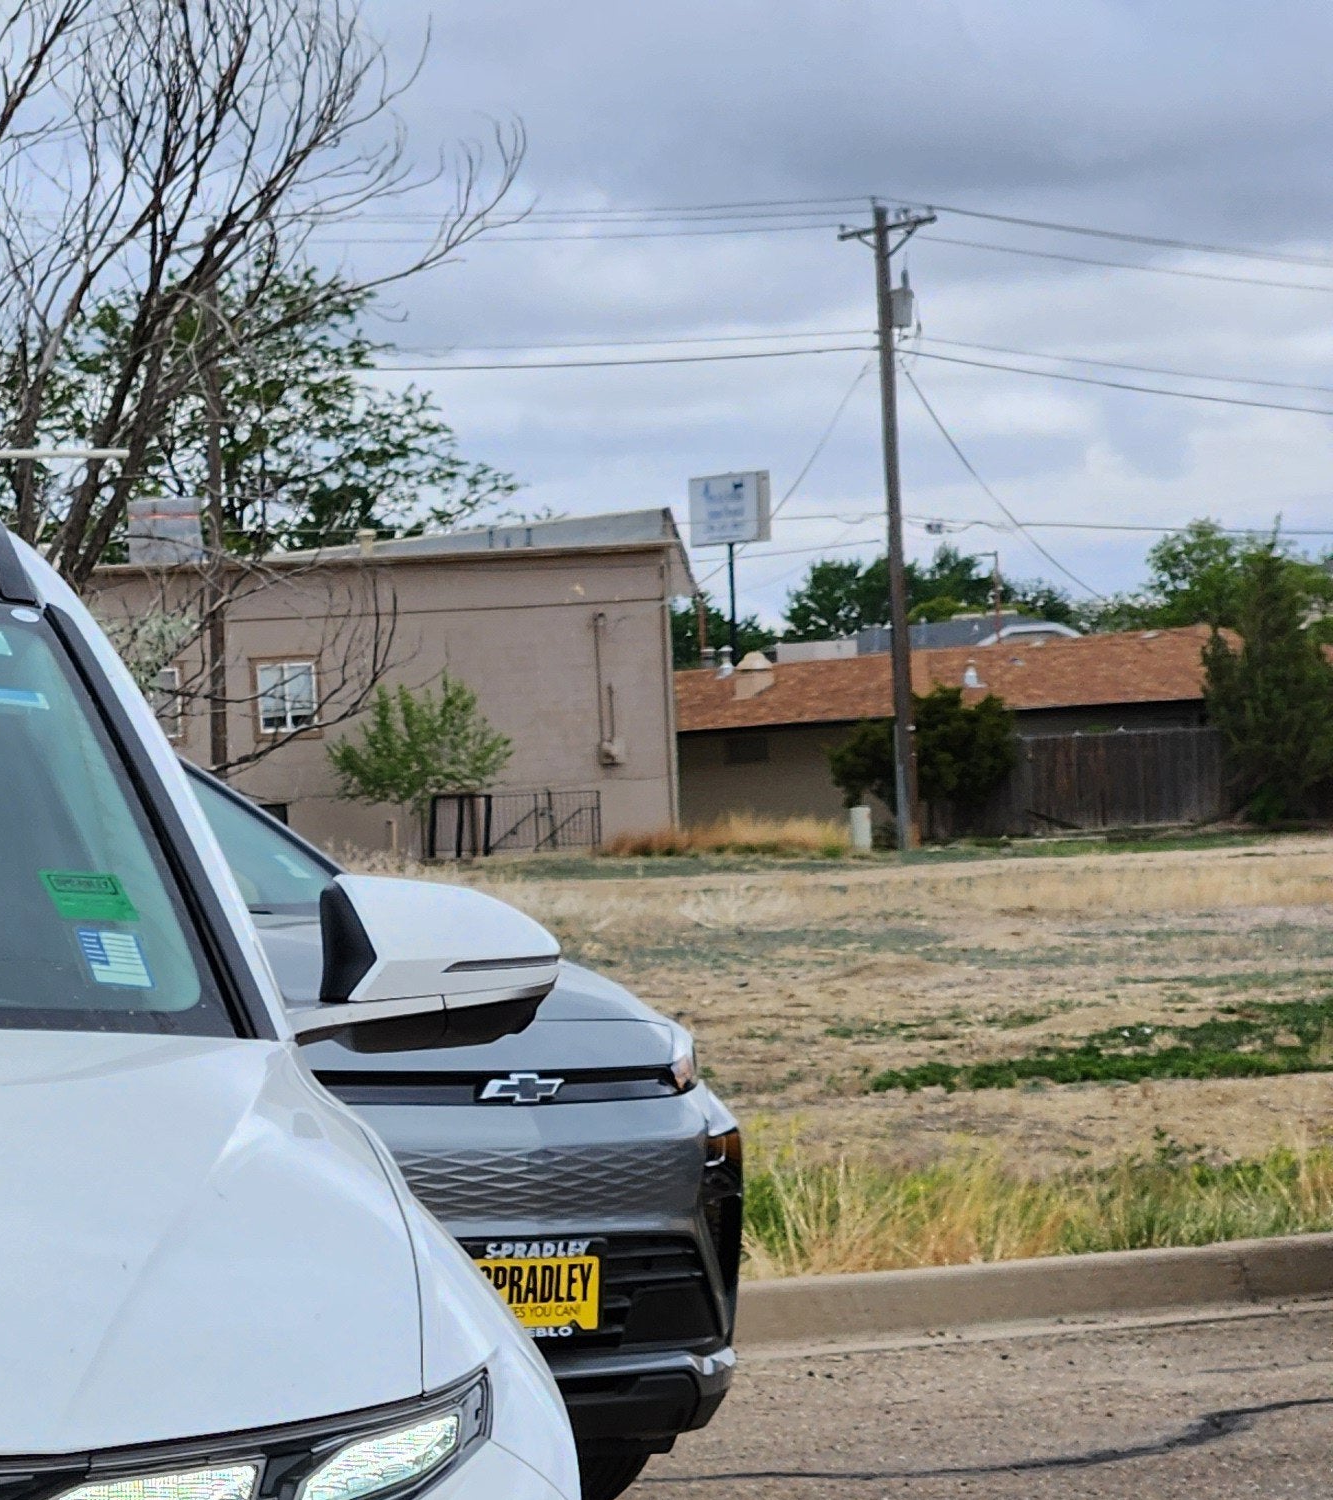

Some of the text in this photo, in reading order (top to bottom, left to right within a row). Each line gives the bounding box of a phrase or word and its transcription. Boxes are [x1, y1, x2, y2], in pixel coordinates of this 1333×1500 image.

[485, 1240, 590, 1259] SPRADLEY
[529, 1305, 552, 1318] YOU
[524, 1326, 573, 1338] EBLO
